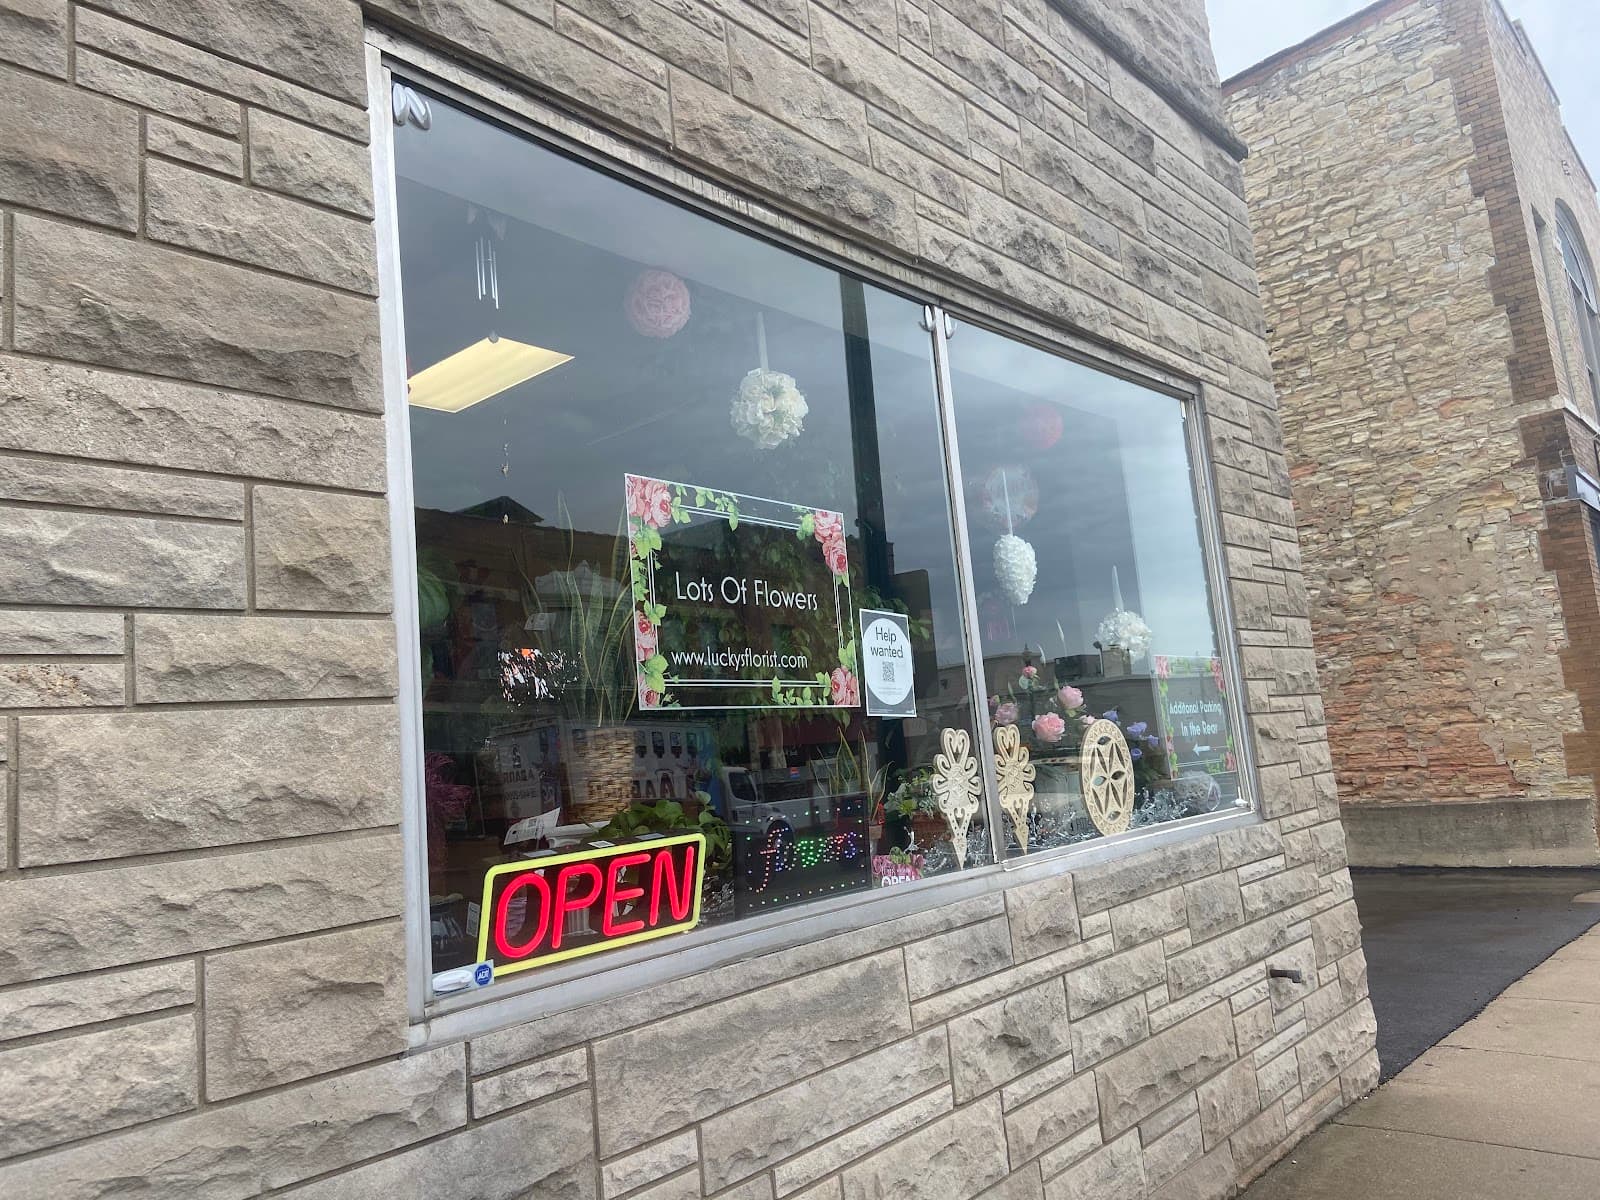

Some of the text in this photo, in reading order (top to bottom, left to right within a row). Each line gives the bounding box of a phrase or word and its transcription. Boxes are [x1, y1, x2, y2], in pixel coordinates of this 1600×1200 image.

[675, 572, 818, 611] Lots Of Flowers
[875, 626, 897, 645] Help
[671, 646, 808, 672] www.luckysflorist.com
[870, 645, 904, 659] wanted
[1199, 700, 1222, 716] Parking
[1181, 720, 1218, 737] In the Rear
[495, 845, 695, 959] OPEN
